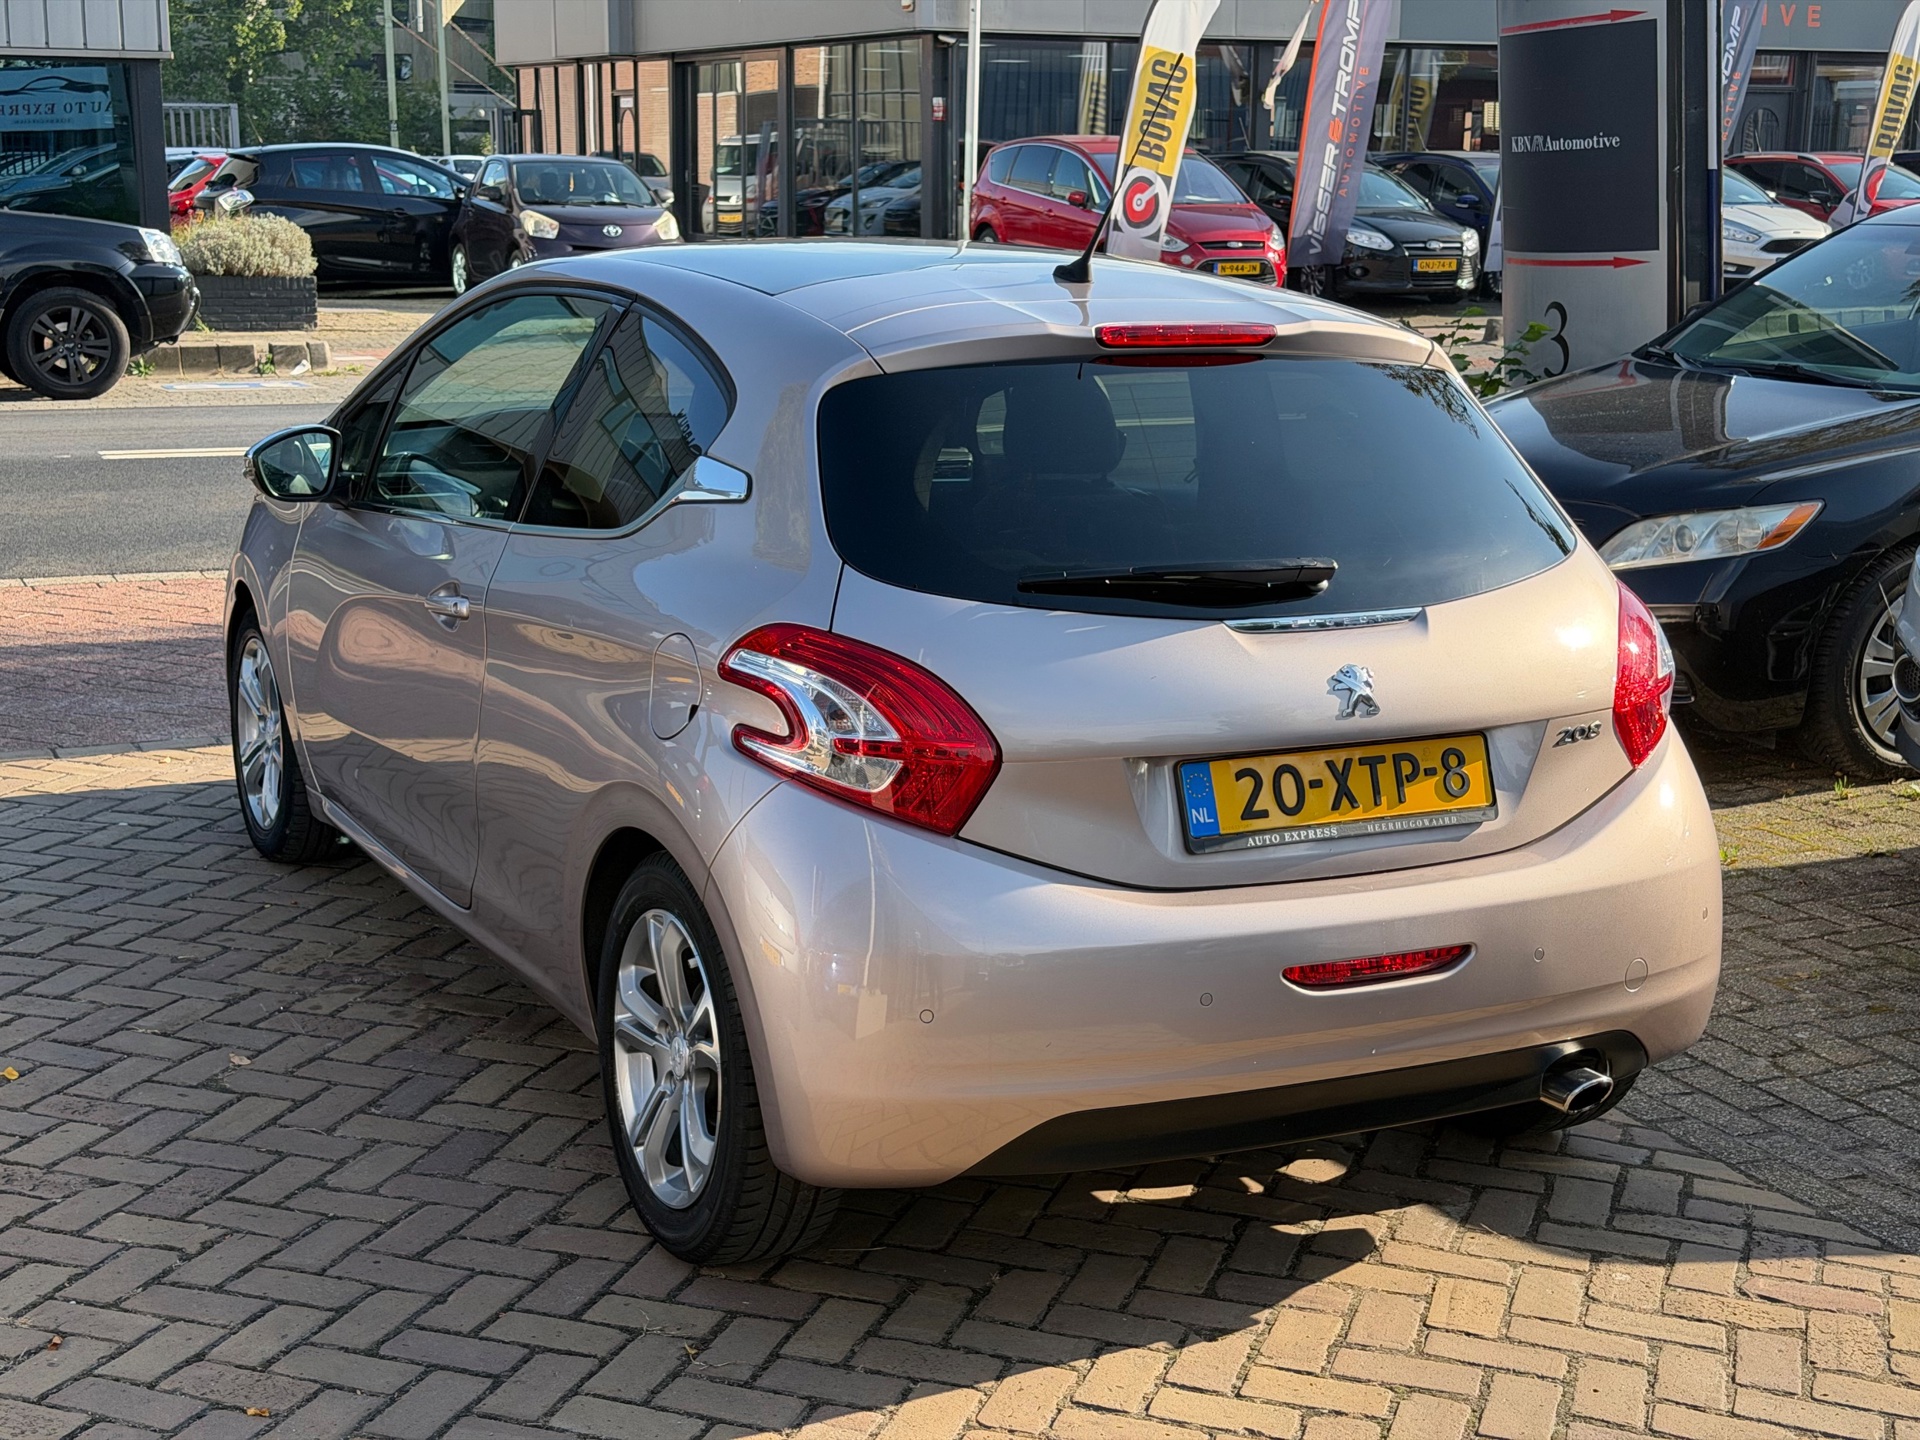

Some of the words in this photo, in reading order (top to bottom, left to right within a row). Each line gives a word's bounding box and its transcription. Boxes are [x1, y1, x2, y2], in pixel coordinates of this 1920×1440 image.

[1337, 67, 1370, 198] AUTOMOTIVE
[1545, 131, 1621, 152] Automotive
[1543, 301, 1570, 378] 3
[1272, 613, 1383, 630] PEUGEOT
[1551, 719, 1603, 749] 208
[1190, 806, 1215, 825] NL
[1234, 746, 1471, 821] 20-XTP-8
[1247, 833, 1281, 847] AUTO
[1284, 826, 1339, 843] EXPRESS
[1366, 815, 1458, 832] HEERHUGOWAARD
